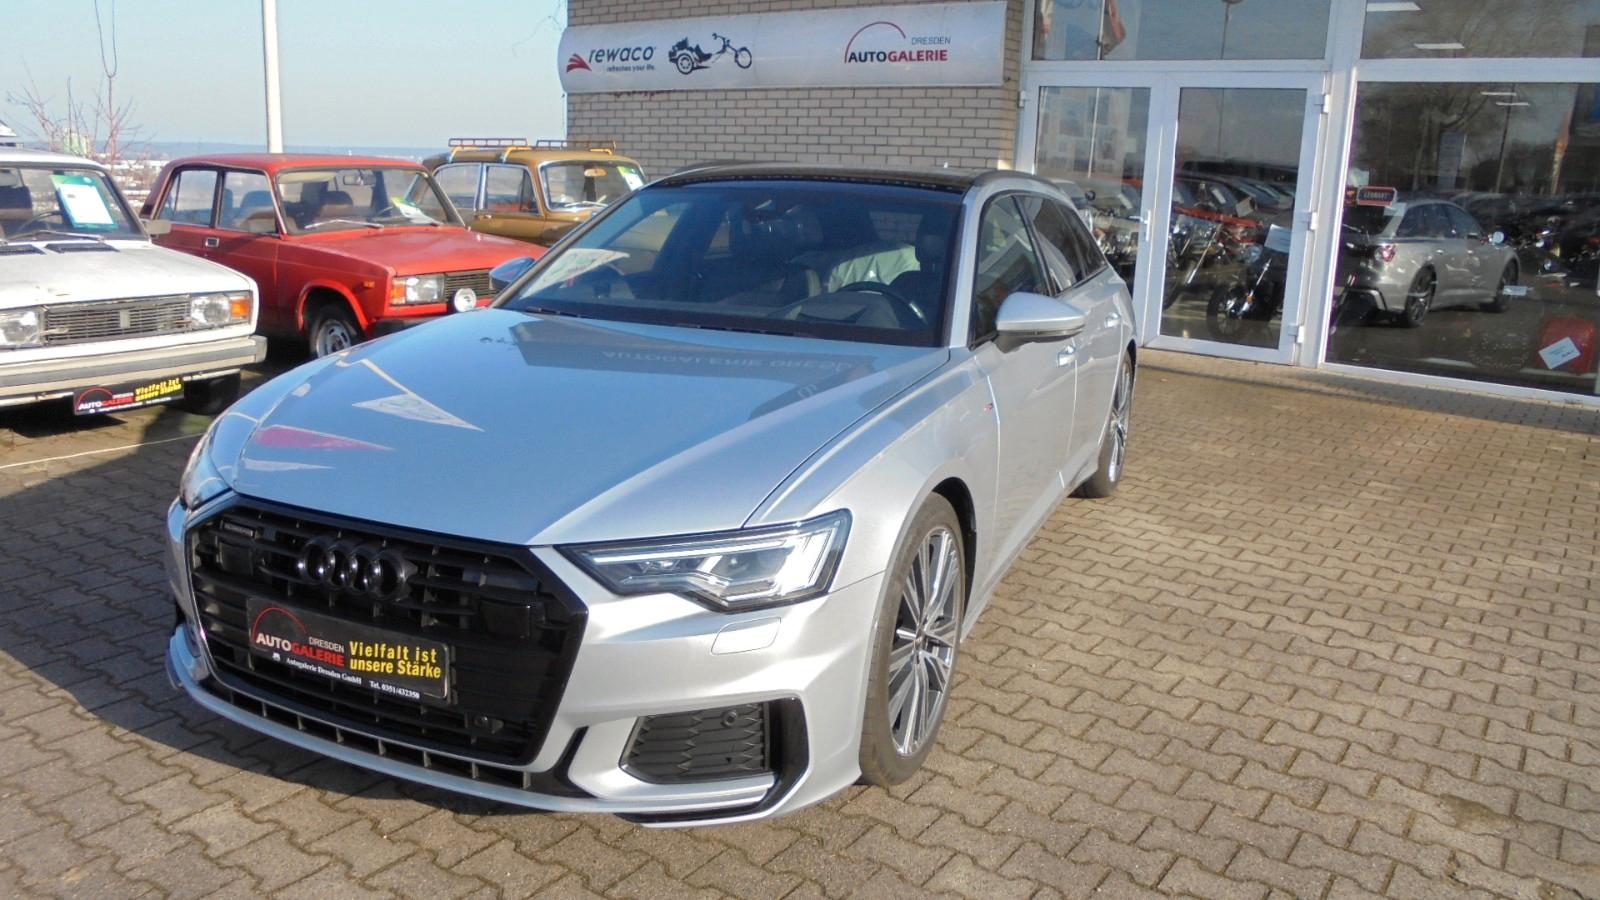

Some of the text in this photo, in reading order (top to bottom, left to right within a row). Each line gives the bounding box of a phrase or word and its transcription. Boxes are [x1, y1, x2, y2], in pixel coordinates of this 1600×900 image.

[911, 36, 951, 45] DRESDEN
[588, 46, 655, 63] rewaco
[848, 49, 948, 63] AUTOGALERIE
[256, 632, 345, 668] AUTOGALERIE
[308, 636, 345, 653] DRESDEN
[349, 641, 437, 663] Vielfalt ist
[349, 658, 441, 678] unsere Stärke
